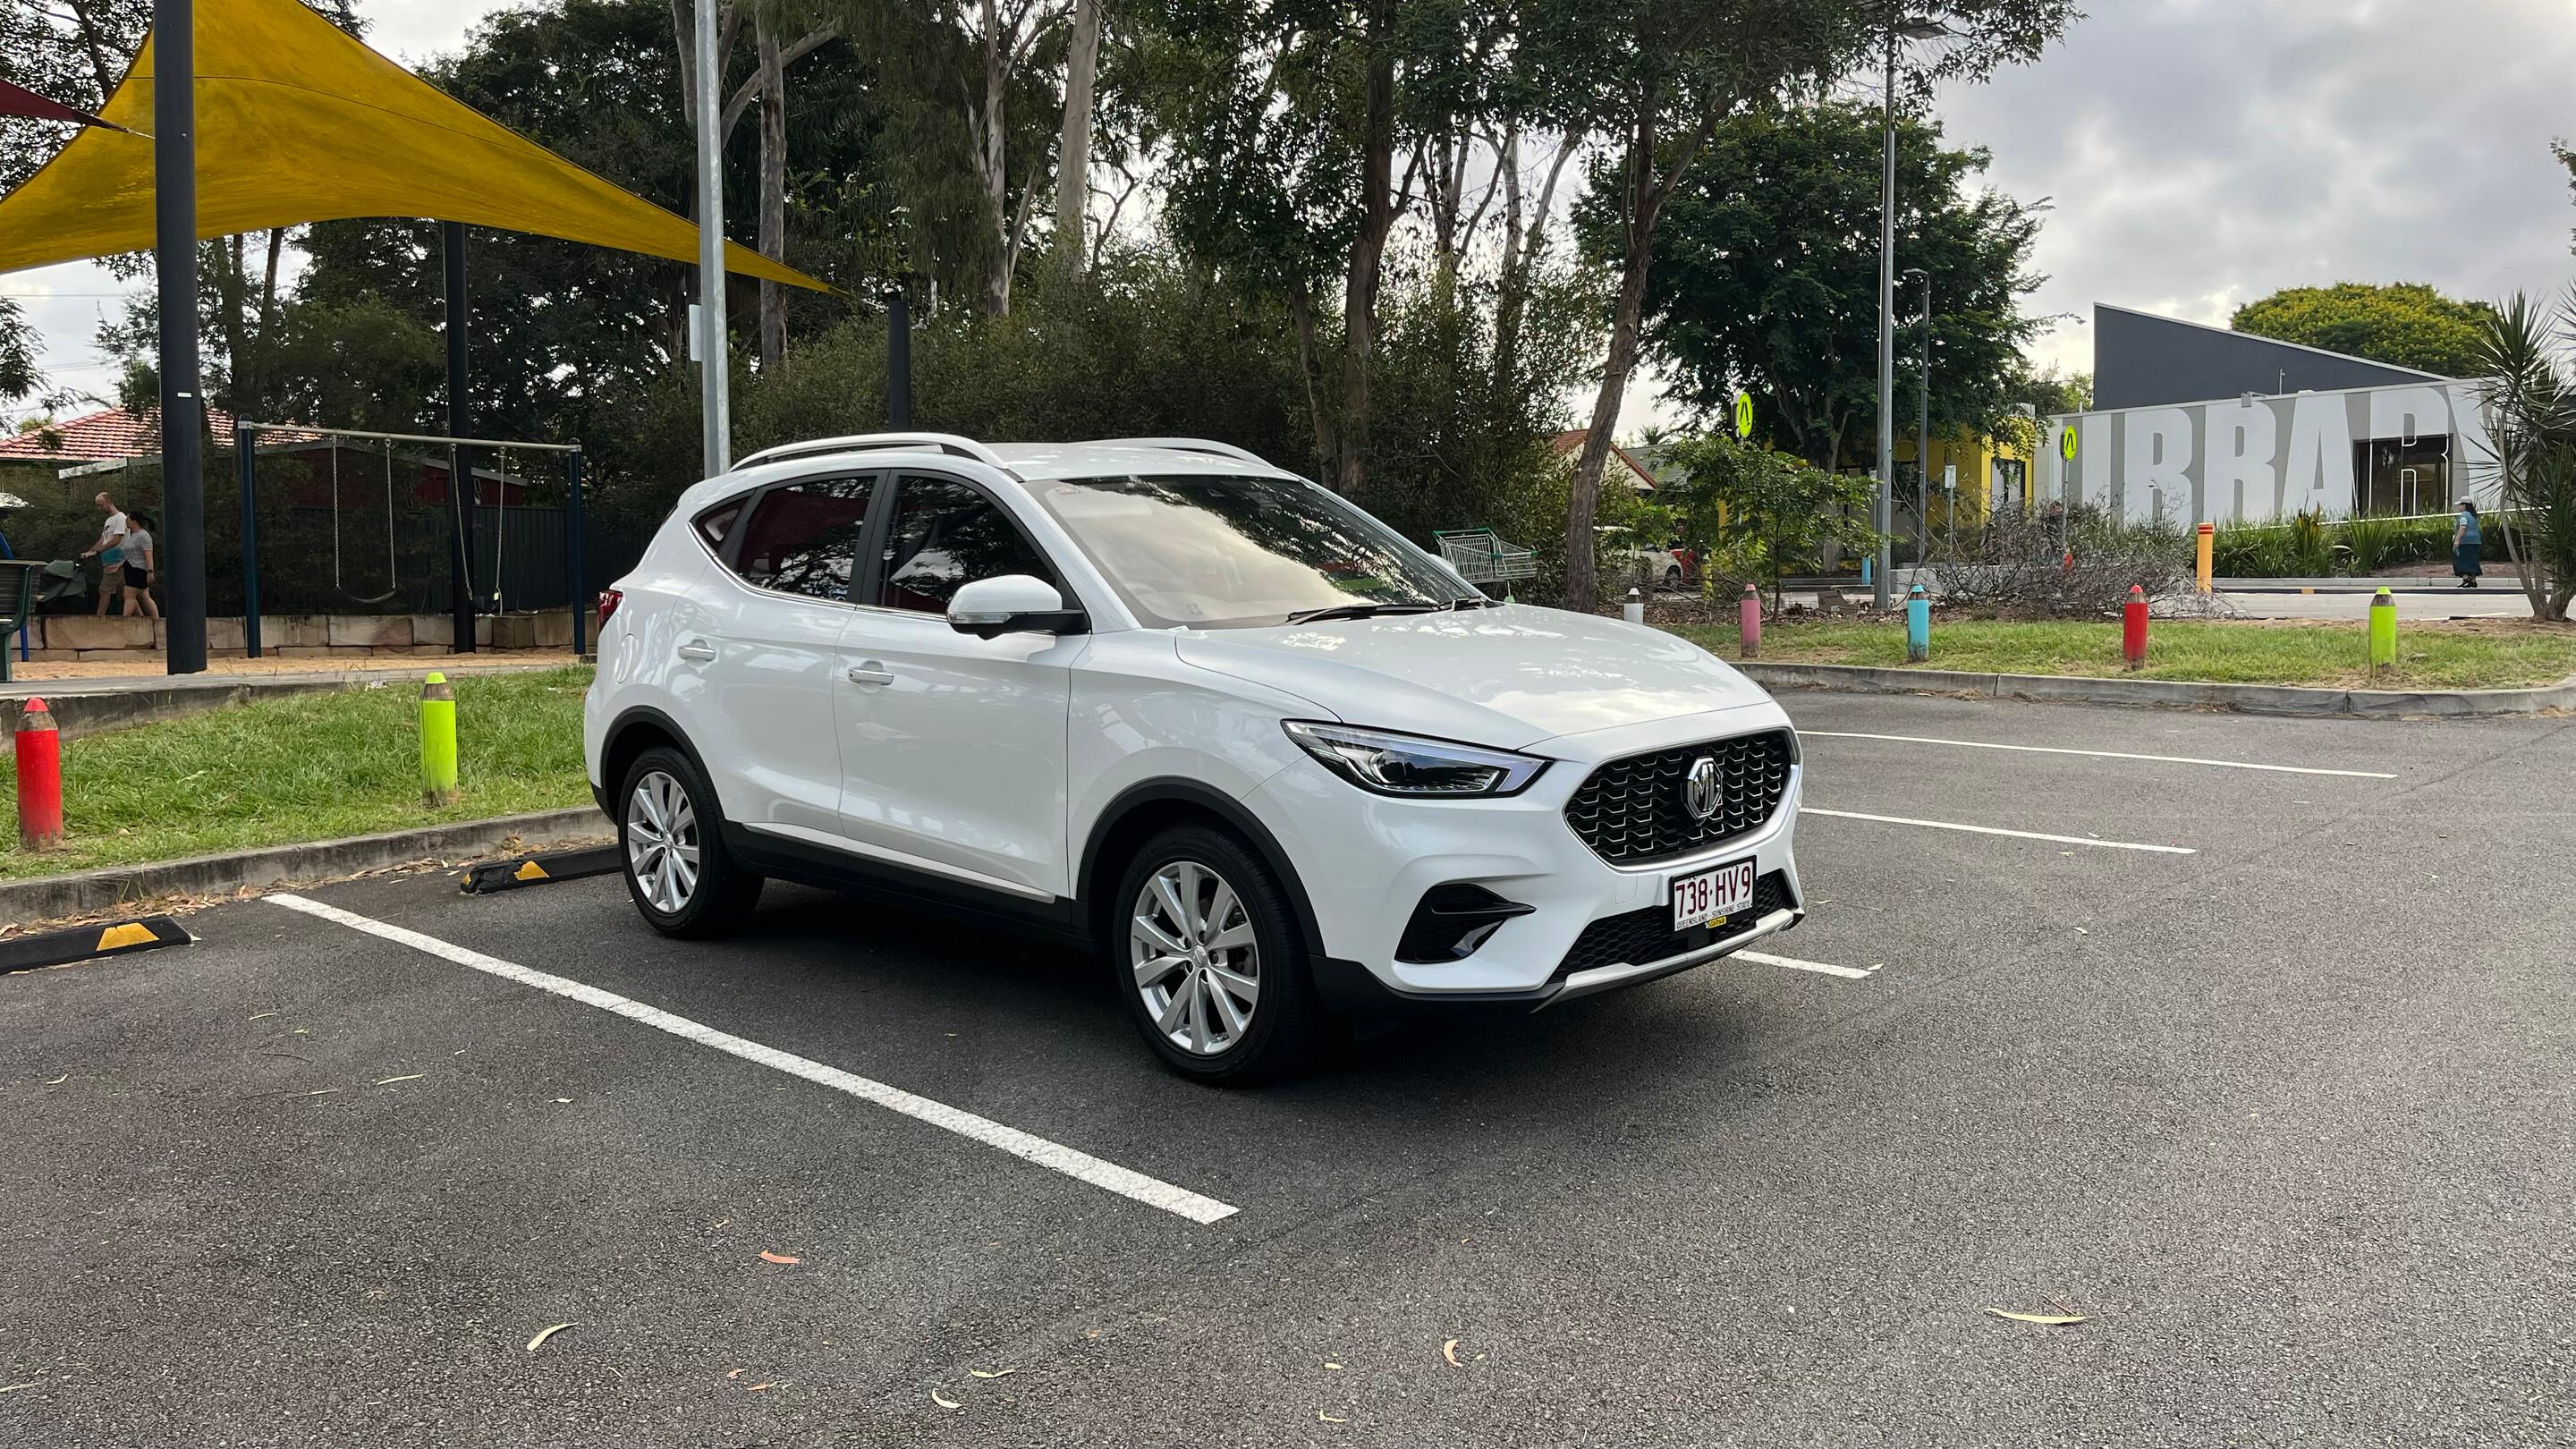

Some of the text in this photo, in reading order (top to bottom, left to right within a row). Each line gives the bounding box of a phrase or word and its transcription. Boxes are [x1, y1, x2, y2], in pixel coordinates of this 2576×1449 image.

[1676, 913, 1708, 929] QUEENSLAND
[1712, 906, 1735, 918] SUNSHINE
[1736, 900, 1750, 911] STATE
